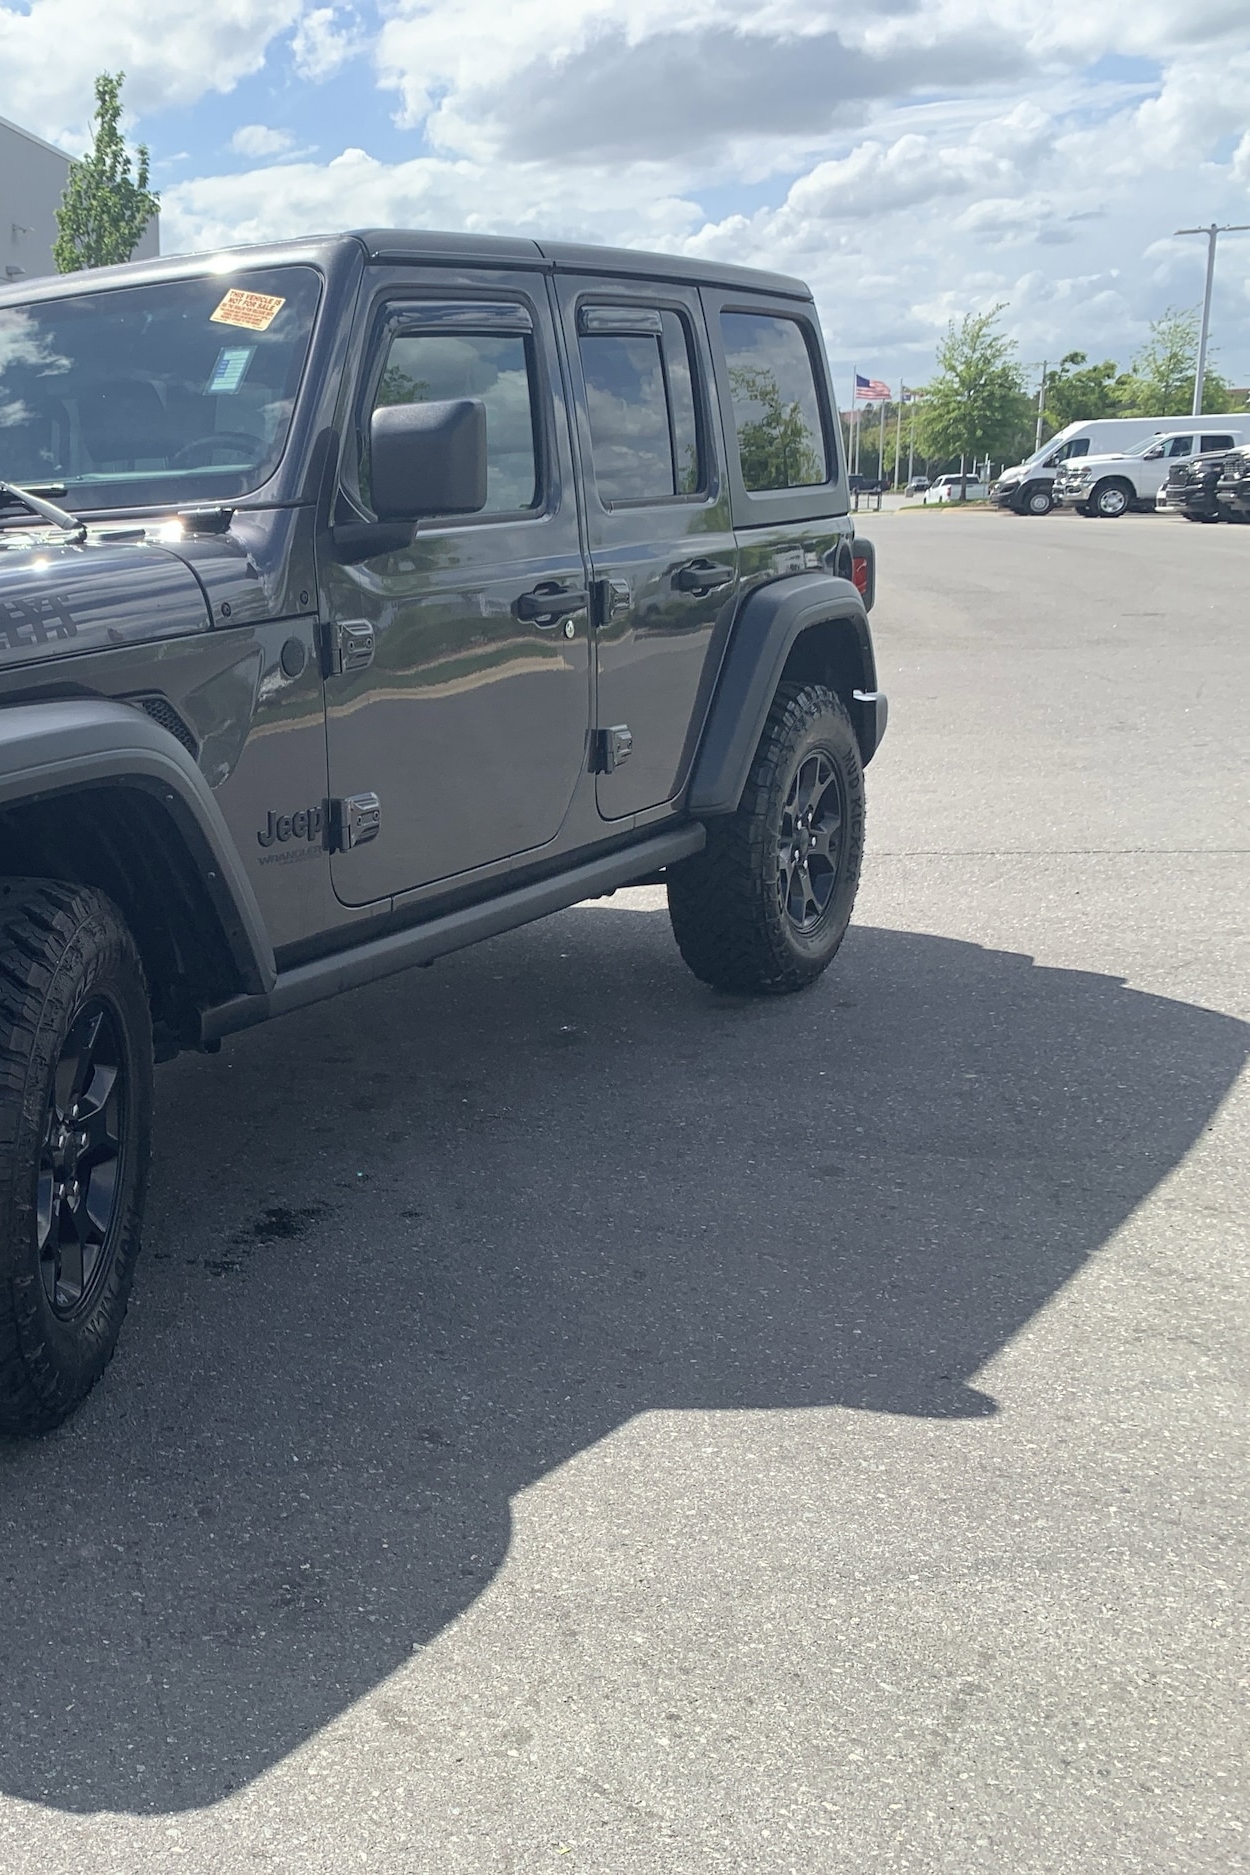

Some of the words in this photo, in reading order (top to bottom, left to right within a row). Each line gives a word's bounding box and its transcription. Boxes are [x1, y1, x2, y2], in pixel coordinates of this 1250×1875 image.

[242, 300, 257, 308] FOR
[258, 303, 275, 312] SALE
[245, 293, 273, 305] VEHICLE
[843, 747, 860, 789] MUD
[257, 806, 325, 848] Jeep
[847, 796, 862, 882] KICKER
